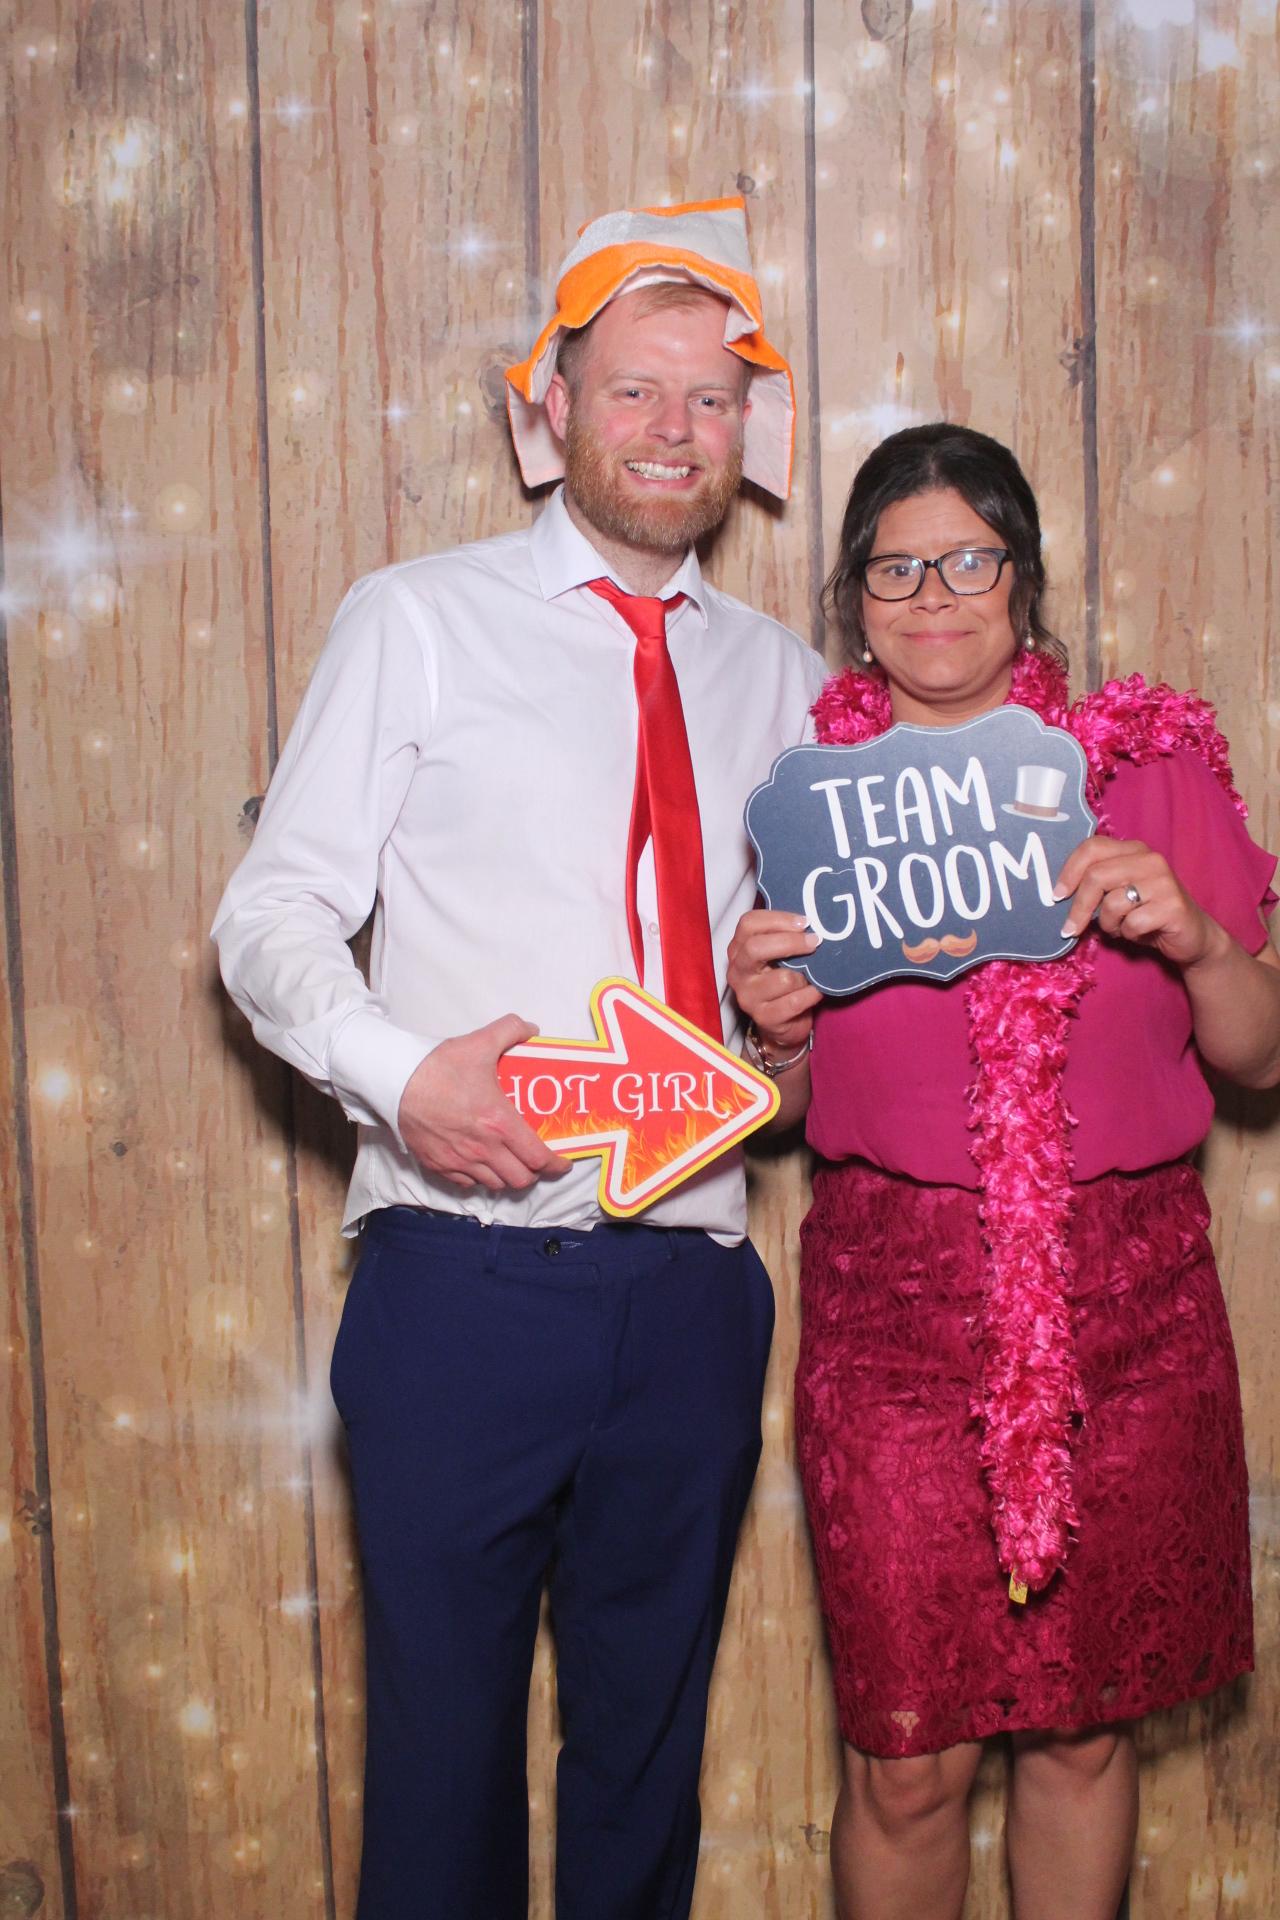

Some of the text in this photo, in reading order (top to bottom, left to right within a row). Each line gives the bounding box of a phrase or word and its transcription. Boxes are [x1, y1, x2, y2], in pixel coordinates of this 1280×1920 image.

[810, 757, 996, 859] TEAM
[802, 832, 1056, 949] GROOM
[612, 1071, 731, 1121] GIRL
